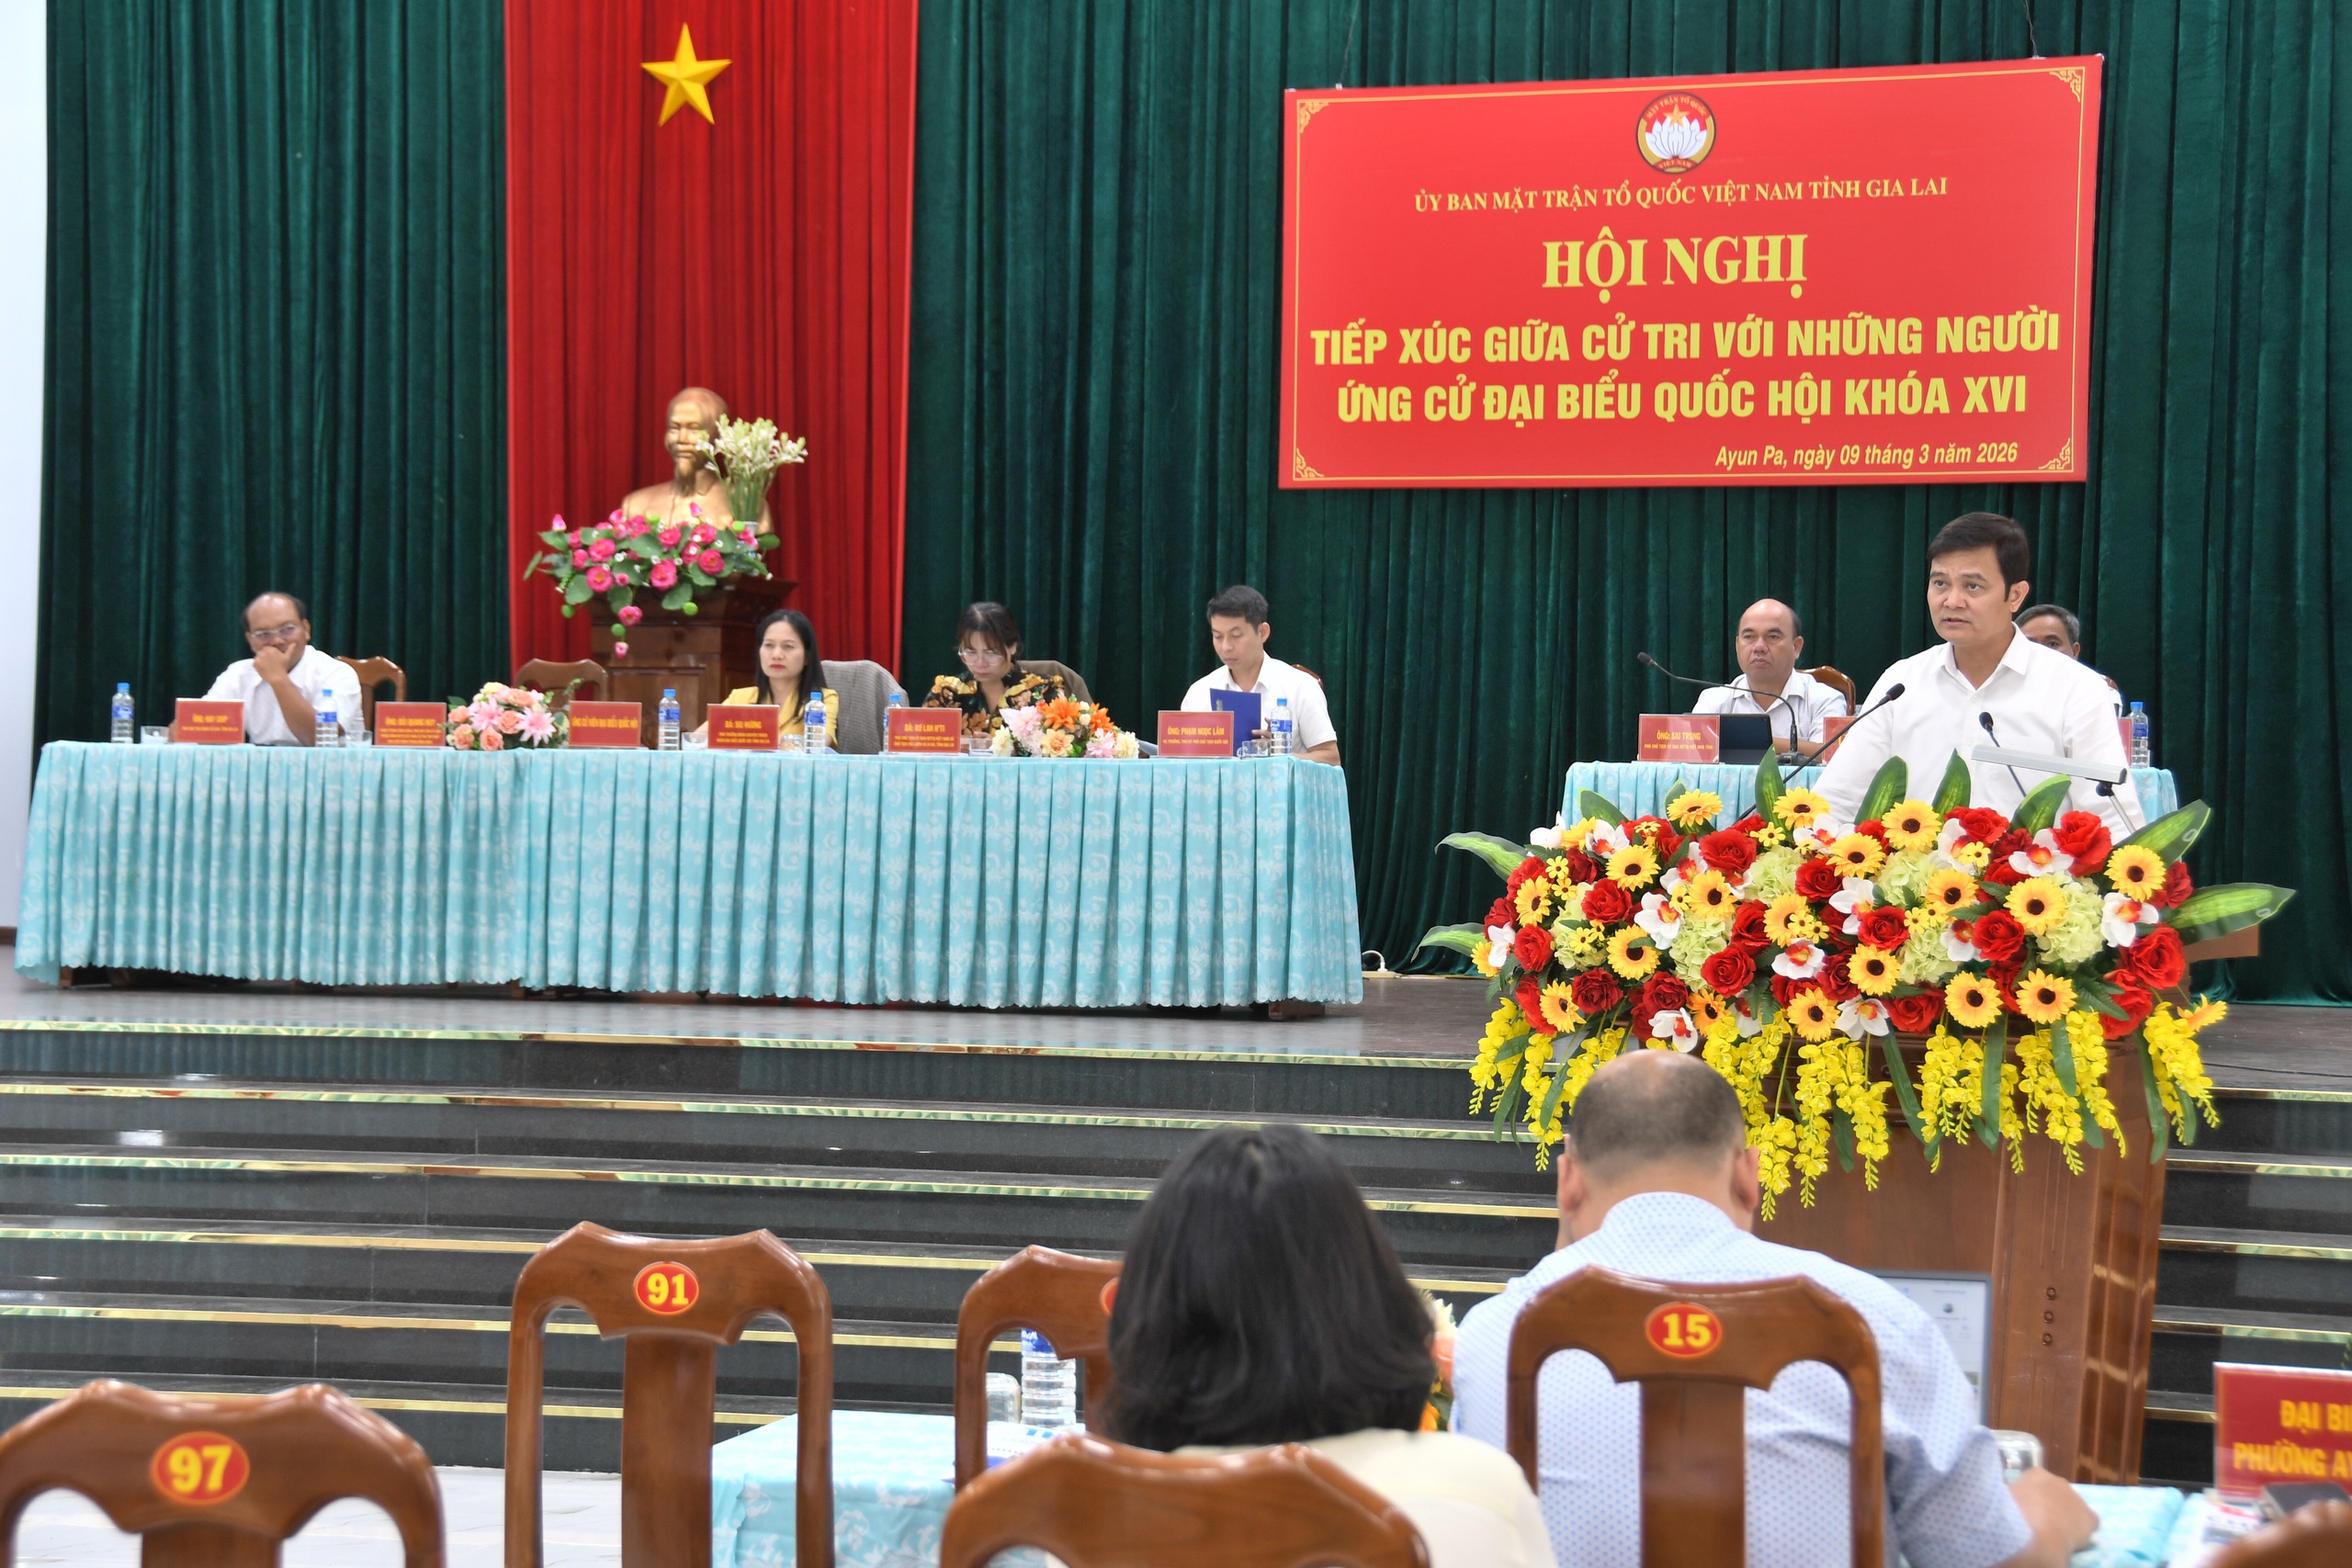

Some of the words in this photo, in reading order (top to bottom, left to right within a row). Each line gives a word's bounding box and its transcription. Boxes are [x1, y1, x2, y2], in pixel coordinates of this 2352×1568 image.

[1416, 188, 1442, 212] ỦY
[1447, 193, 1487, 211] BAN
[1492, 187, 1538, 214] MẶT
[1543, 185, 1598, 212] TRẬN
[1603, 179, 1631, 207] TỔ
[1636, 178, 1696, 209] QUỐC
[1702, 180, 1750, 207] VIỆT
[1755, 182, 1804, 201] NAM
[1808, 175, 1861, 199] TỈNH
[1866, 179, 1905, 197] GIA
[1911, 177, 1948, 197] LAI
[1543, 226, 1648, 303] HỘI
[1663, 234, 1808, 299] NGHỊ
[1310, 318, 1387, 366] TIẾP
[1398, 321, 1472, 365] XÚC
[1484, 319, 1570, 363] GIỮA
[1581, 312, 1636, 361] CỬ
[1643, 322, 1701, 360] TRI
[1713, 314, 1774, 358] VỚI
[1787, 311, 1923, 357] NHỮNG
[1937, 305, 2060, 354] NGƯỜI
[1338, 378, 1412, 423] ỨNG
[1423, 374, 1477, 422] CỬ
[1482, 384, 1544, 428] ĐẠI
[1556, 368, 1642, 420] BIỂU
[1655, 368, 1755, 423] QUỐC
[1768, 372, 1832, 424] HỘI
[1845, 370, 1951, 416] KHÓA
[1962, 376, 2027, 413] XVI
[1715, 446, 1758, 471] Ayun
[1762, 445, 1788, 469] Pa,
[1792, 444, 1837, 471] ngày
[1839, 445, 1860, 466] 09
[1864, 444, 1915, 470] tháng
[1918, 444, 1930, 465] 3
[1933, 443, 1972, 464] năm
[1975, 442, 2018, 464] 2026
[647, 1272, 689, 1305] 91
[1663, 1313, 1711, 1348] 15
[2279, 1399, 2321, 1434] ĐẠI
[2327, 1403, 2352, 1432] BI
[168, 1444, 232, 1493] 97
[2233, 1438, 2327, 1477] PHƯỜNG
